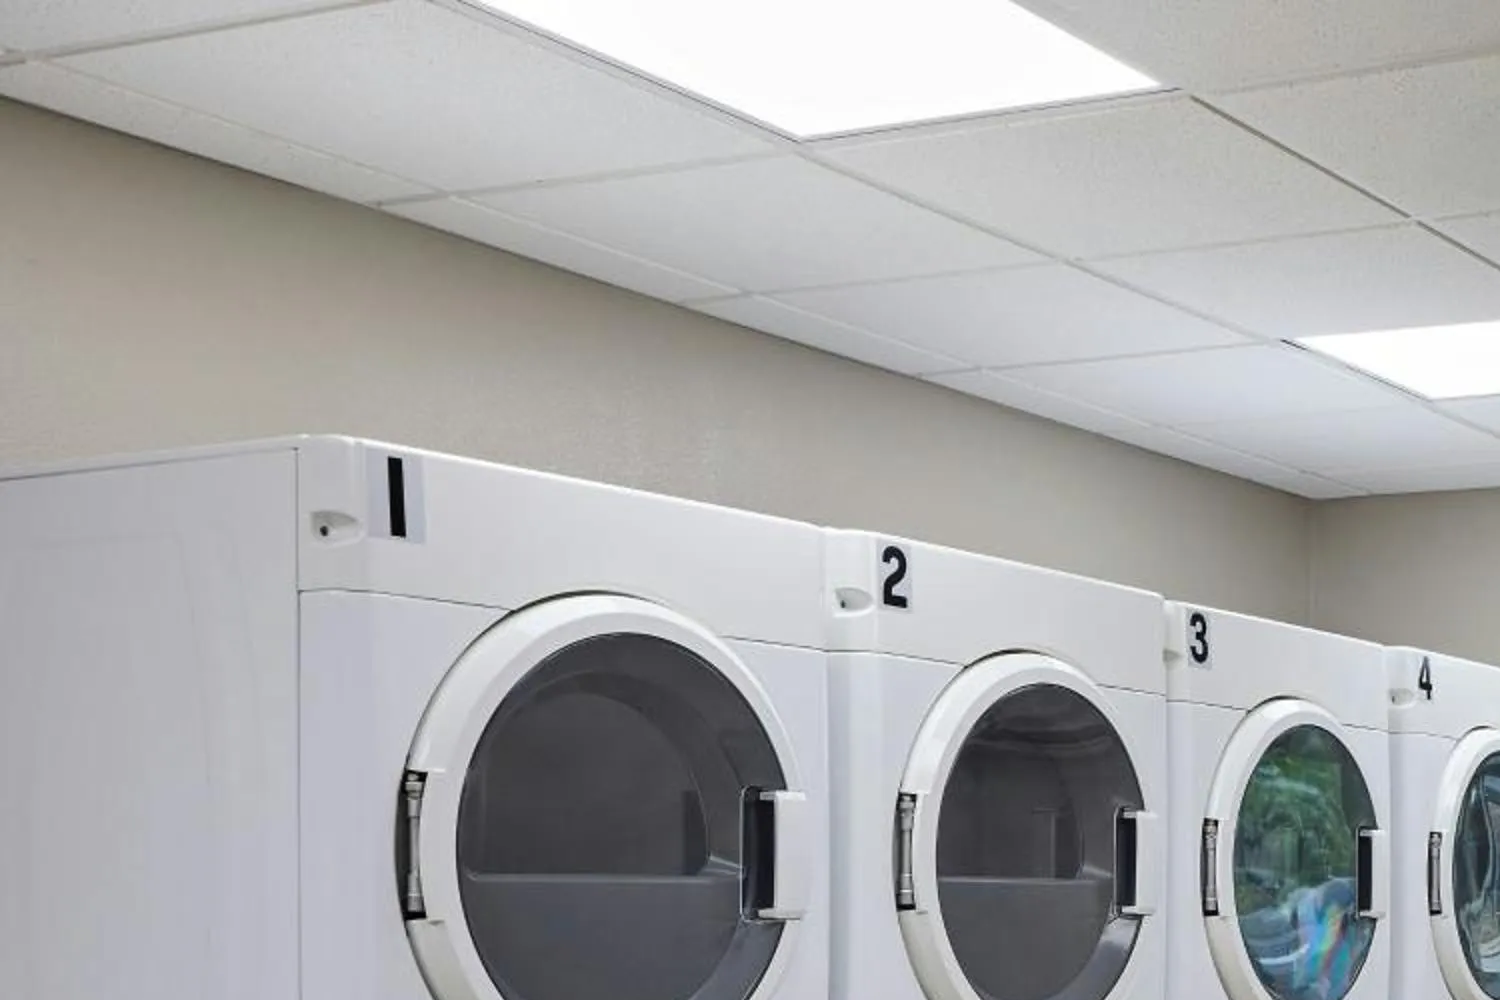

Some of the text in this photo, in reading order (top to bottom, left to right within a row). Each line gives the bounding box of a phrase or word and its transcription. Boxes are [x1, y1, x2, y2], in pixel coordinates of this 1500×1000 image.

[882, 546, 908, 608] 2
[1189, 612, 1209, 664] 3
[1418, 656, 1433, 700] 4
